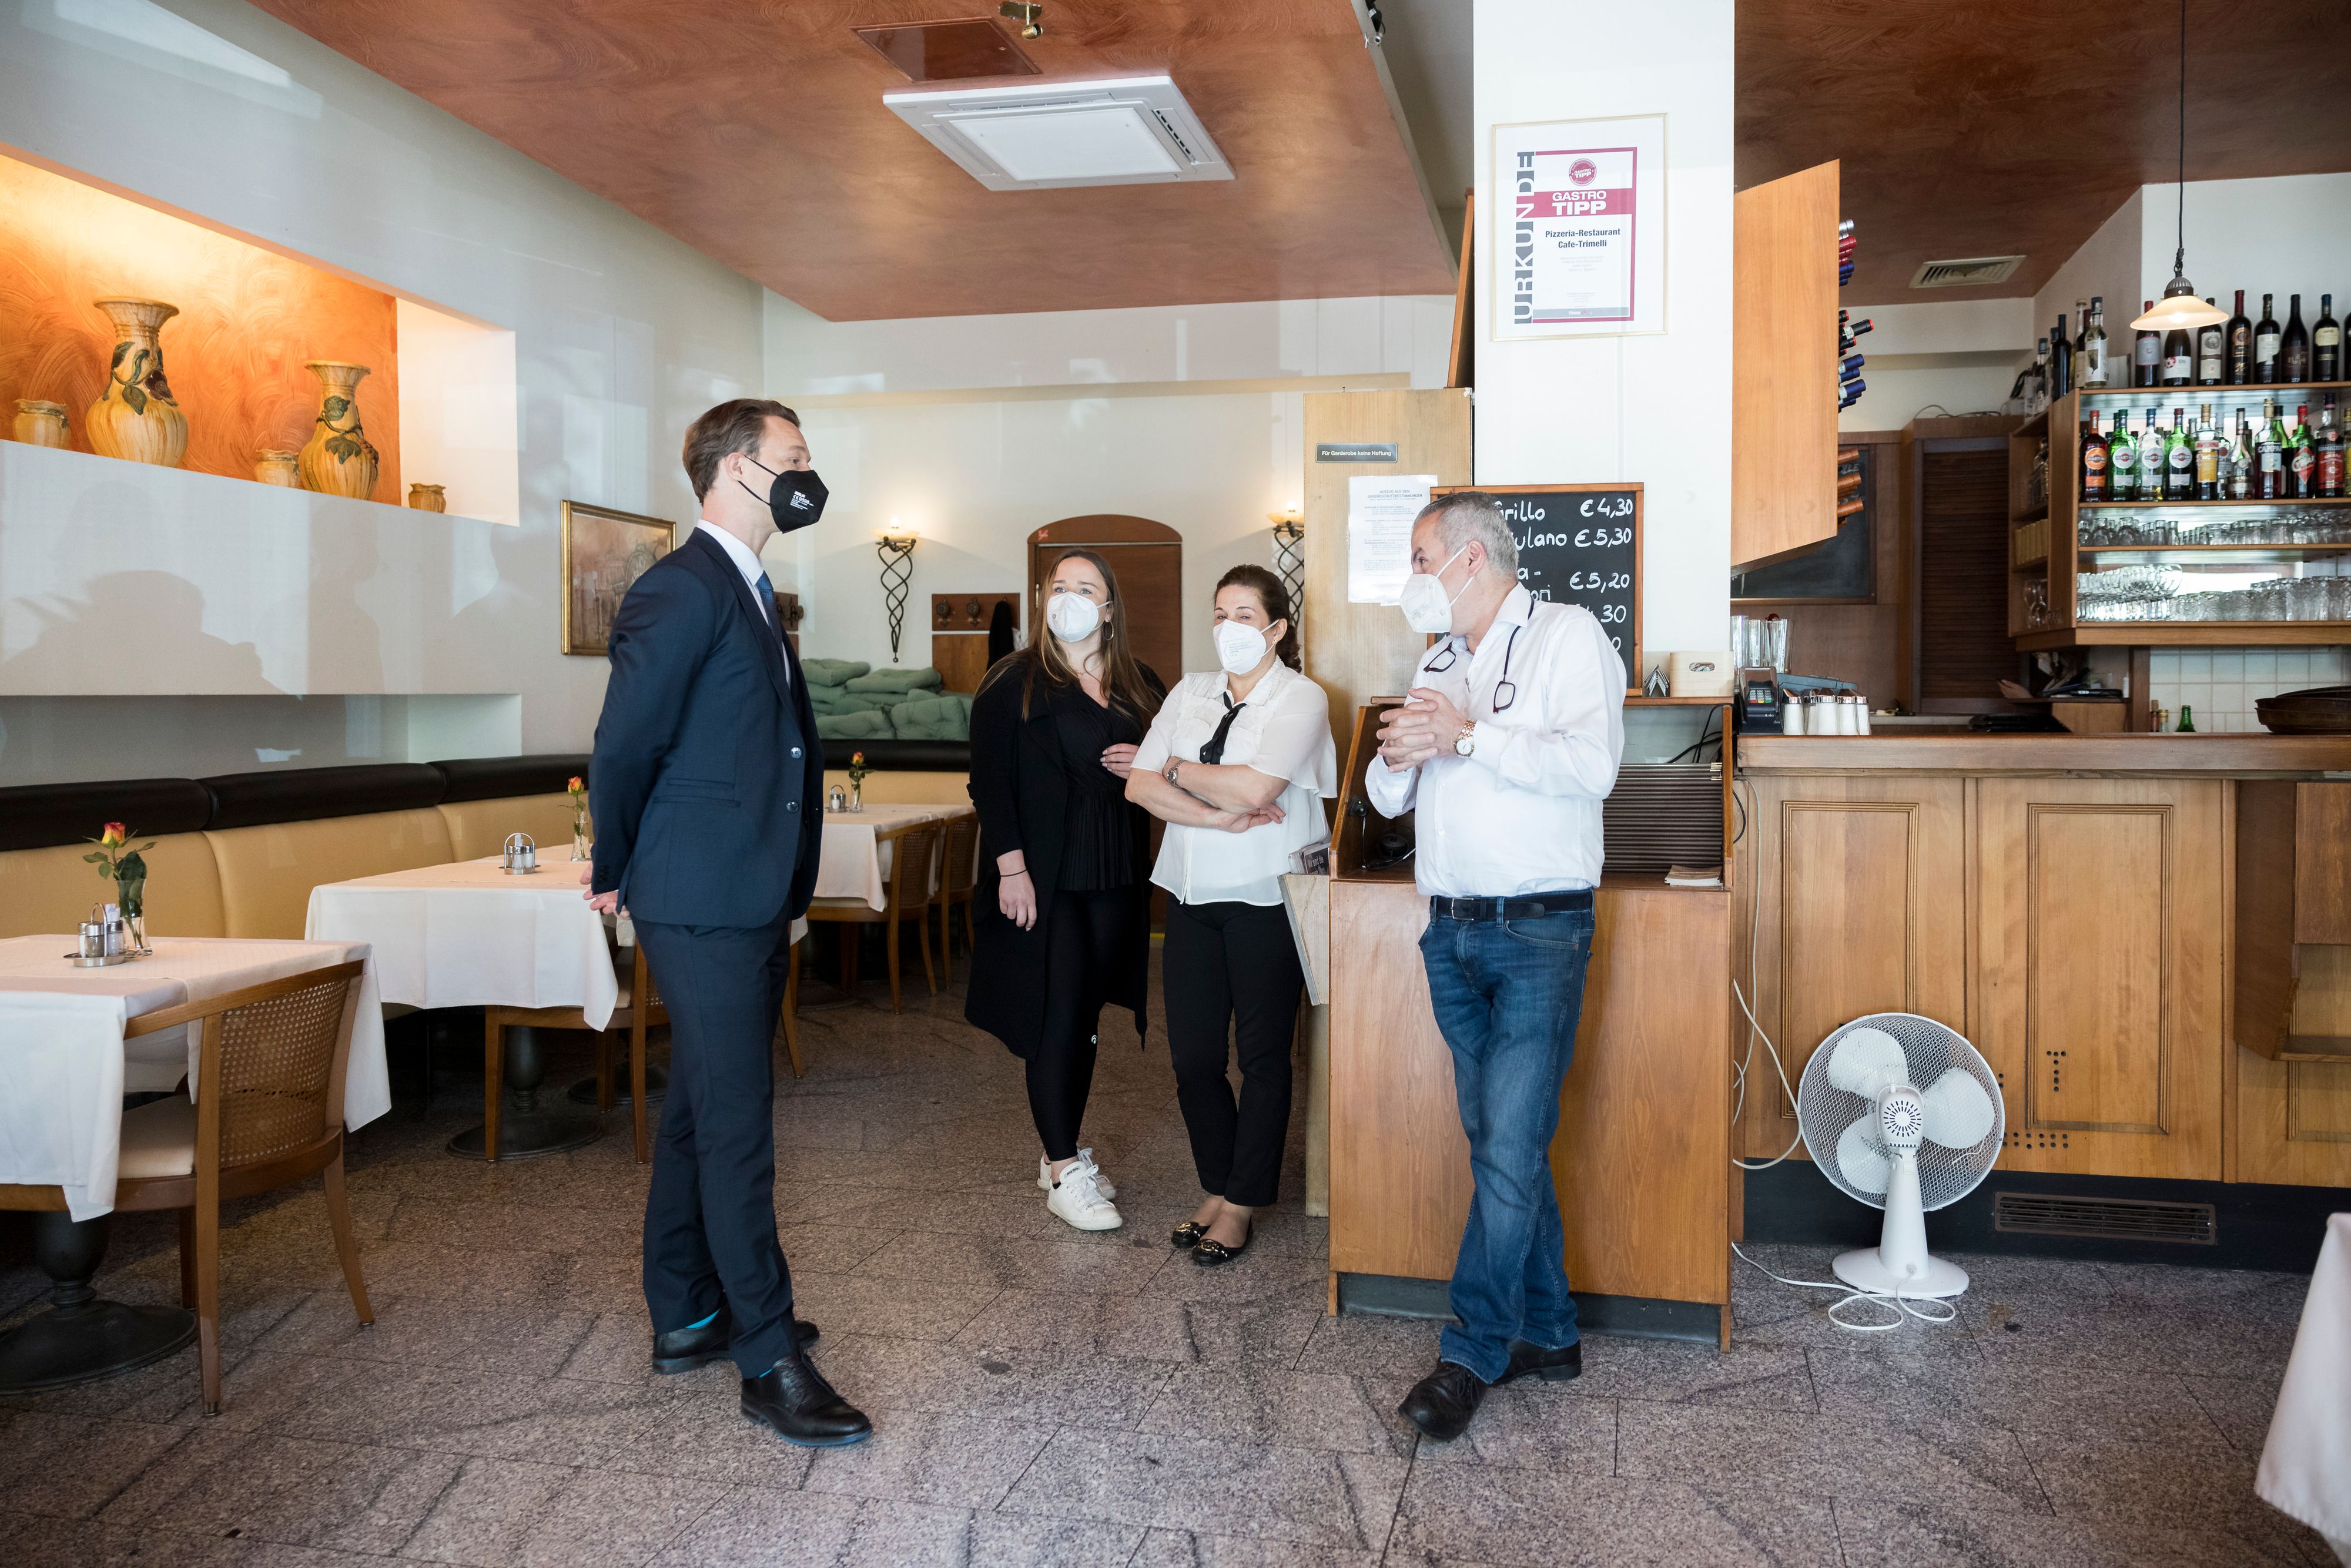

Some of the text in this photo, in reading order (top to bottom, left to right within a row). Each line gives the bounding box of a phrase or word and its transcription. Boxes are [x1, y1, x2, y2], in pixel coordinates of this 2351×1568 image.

[1552, 190, 1607, 201] GASTRO
[1552, 200, 1607, 216] TIPP
[1515, 152, 1535, 324] URKUNDE
[1545, 228, 1620, 237] Pizzeria-Restaurant
[1558, 239, 1607, 248] Cafe-Trimelli
[1511, 527, 1568, 551] ulano
